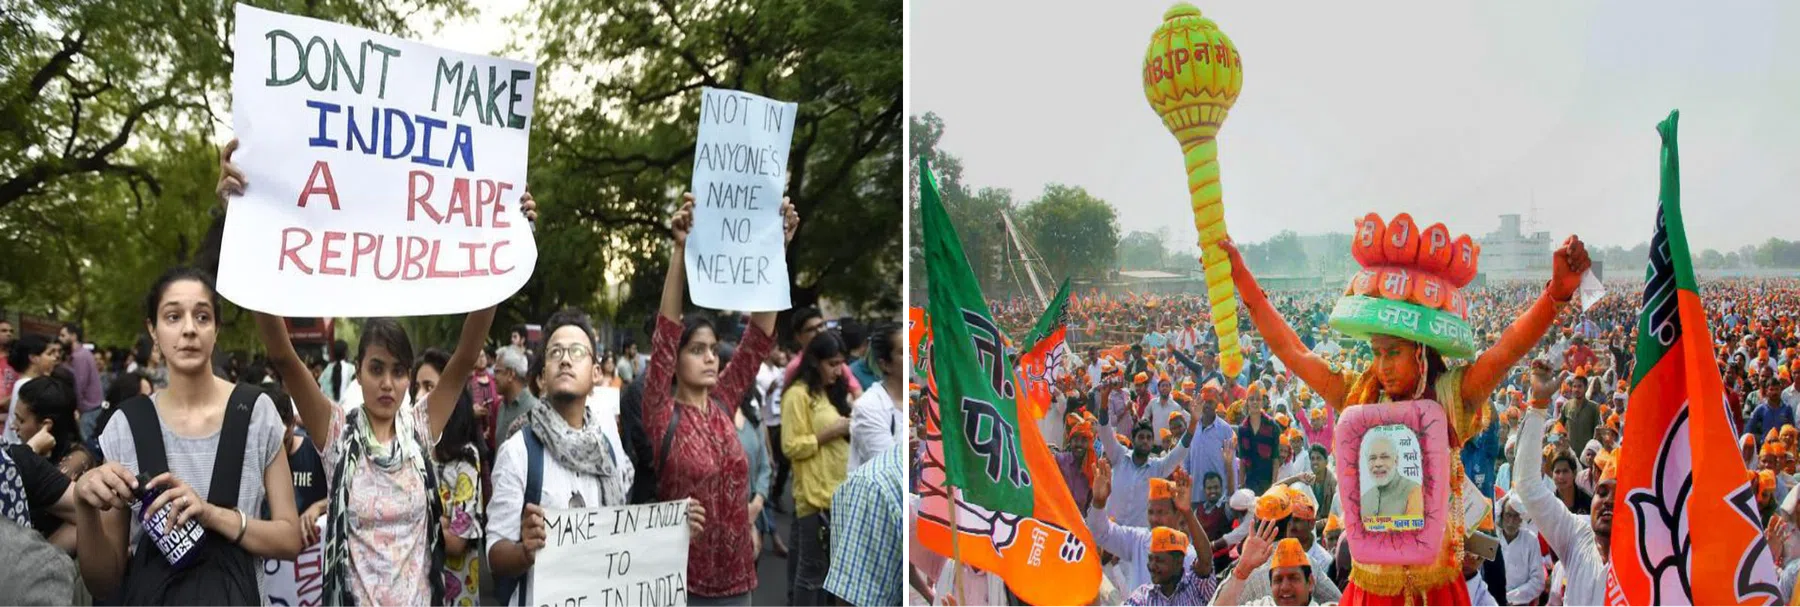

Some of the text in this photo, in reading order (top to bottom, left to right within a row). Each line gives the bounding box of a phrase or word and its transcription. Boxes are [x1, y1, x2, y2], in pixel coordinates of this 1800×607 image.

[265, 29, 531, 129] DON'T MAKE
[1152, 47, 1189, 84] BJP
[703, 92, 784, 133] NOT IN
[306, 100, 475, 171] INDIA
[696, 142, 781, 178] ANYONE'S
[297, 160, 513, 228] A RAPE
[278, 227, 515, 280] REPUBLIC
[697, 253, 772, 285] NEVER
[1378, 304, 1421, 331] जय
[293, 471, 313, 487] THE
[1403, 463, 1420, 477] नमो
[543, 512, 598, 547] MAKE
[610, 508, 640, 535] IN
[605, 550, 631, 579] TO
[602, 572, 687, 607] IN INDIA
